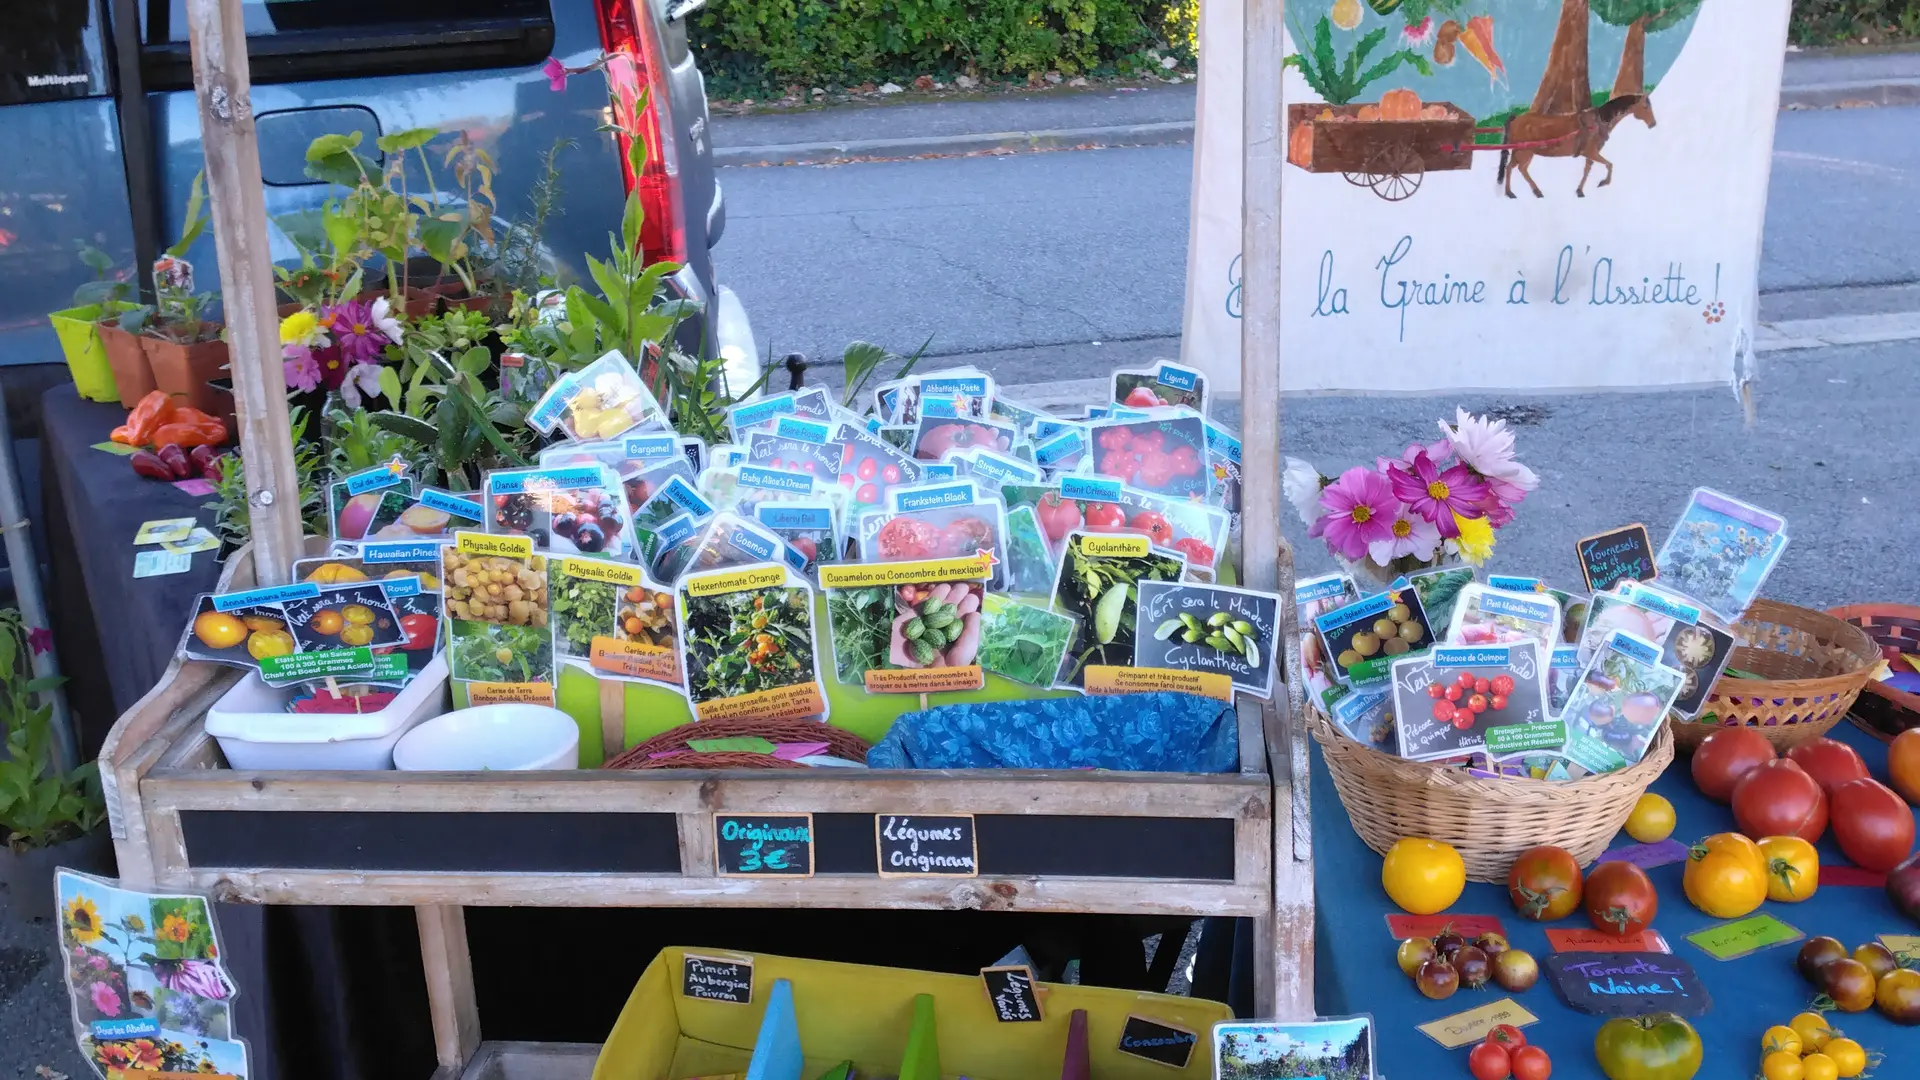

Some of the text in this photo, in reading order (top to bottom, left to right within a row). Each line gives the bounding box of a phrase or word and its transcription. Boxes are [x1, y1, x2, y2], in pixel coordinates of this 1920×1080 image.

[27, 74, 88, 87] Multispace
[1311, 249, 1350, 319] la
[1375, 234, 1486, 343] Graine
[1506, 269, 1530, 305] à
[1164, 371, 1189, 387] Liguria
[960, 383, 980, 393] Paste
[630, 443, 670, 455] Gargamel
[750, 442, 774, 460] Vert
[778, 441, 799, 452] sera
[976, 459, 1004, 478] Striped
[351, 474, 397, 490] Cul de Singe
[494, 478, 519, 491] Danse
[741, 472, 761, 485] Baby
[786, 478, 811, 491] Dream
[670, 485, 693, 507] Jasper
[1063, 483, 1118, 498] Giant Crimson
[902, 491, 968, 509] Frankstein Black
[449, 502, 459, 510] du
[459, 504, 475, 515] Lac
[462, 538, 527, 554] Physalis Goldie
[735, 532, 769, 557] Cosmos
[1088, 541, 1142, 554] Cyclanthère
[1584, 536, 1640, 562] Tournesols
[368, 549, 411, 559] Hawaiian
[1609, 554, 1619, 566] et
[569, 562, 633, 582] Physalis Goldie
[827, 570, 874, 583] Cucamelon
[887, 568, 936, 581] Concombre
[937, 565, 949, 577] du
[949, 564, 985, 578] mexique
[1591, 562, 1627, 589] Haricots
[387, 584, 413, 593] Rouge
[692, 572, 781, 593] Hexentomate Orange
[1313, 584, 1342, 597] Lucky Tiger
[221, 587, 314, 608] Anna Banana Russian
[312, 598, 332, 613] sera
[1140, 591, 1264, 628] Vert sera le Monde
[1323, 615, 1344, 627] Sweet
[1342, 608, 1365, 623] Splash
[1528, 606, 1549, 618] Rouge
[317, 657, 354, 666] Grammes
[329, 650, 356, 658] Saison
[1164, 646, 1250, 676] Cyclanthère
[1437, 652, 1507, 665] Précoce de Quimper
[263, 671, 285, 680] Chair
[298, 667, 322, 675] Boeuf
[347, 662, 374, 670] Acidité
[385, 669, 404, 677] Frais
[872, 671, 969, 682] Très Productif, mini concombre
[1118, 670, 1201, 683] Grimpant et très productif
[869, 681, 893, 692] croquer
[908, 680, 928, 689] mettre
[928, 680, 945, 688] dans
[945, 679, 952, 687] le
[952, 677, 979, 689] vinaigre
[1087, 685, 1103, 693] Aide
[1124, 680, 1159, 688] consomme
[1159, 680, 1175, 689] farci
[1184, 683, 1203, 692] sauté
[1397, 668, 1434, 695] Vert
[473, 694, 497, 702] Bonbon
[507, 686, 516, 695] de
[699, 687, 816, 716] Taille d'une groseille, goût acidulé,
[738, 703, 771, 716] confiture
[771, 703, 782, 712] ou
[790, 696, 810, 707] Tarte
[1344, 701, 1366, 717] Lemon
[774, 706, 812, 717] résistante
[1493, 723, 1557, 736] Bretagne Précoce
[1523, 731, 1555, 740] Grammes
[1409, 742, 1420, 753] de
[1421, 725, 1452, 746] Quimper
[1488, 741, 1521, 751] Productive
[1530, 737, 1565, 747] Résistante
[722, 820, 812, 850] Originaux
[883, 816, 962, 851] Légumes
[890, 850, 975, 873] Originaux
[686, 958, 739, 976] Piment
[1562, 960, 1684, 979] Tomate
[688, 972, 749, 992] Aubergine
[690, 985, 738, 1001] Poivron
[1005, 971, 1033, 1020] Légumes
[994, 993, 1014, 1021] Variés
[94, 1023, 156, 1037] Pour les Abeilles
